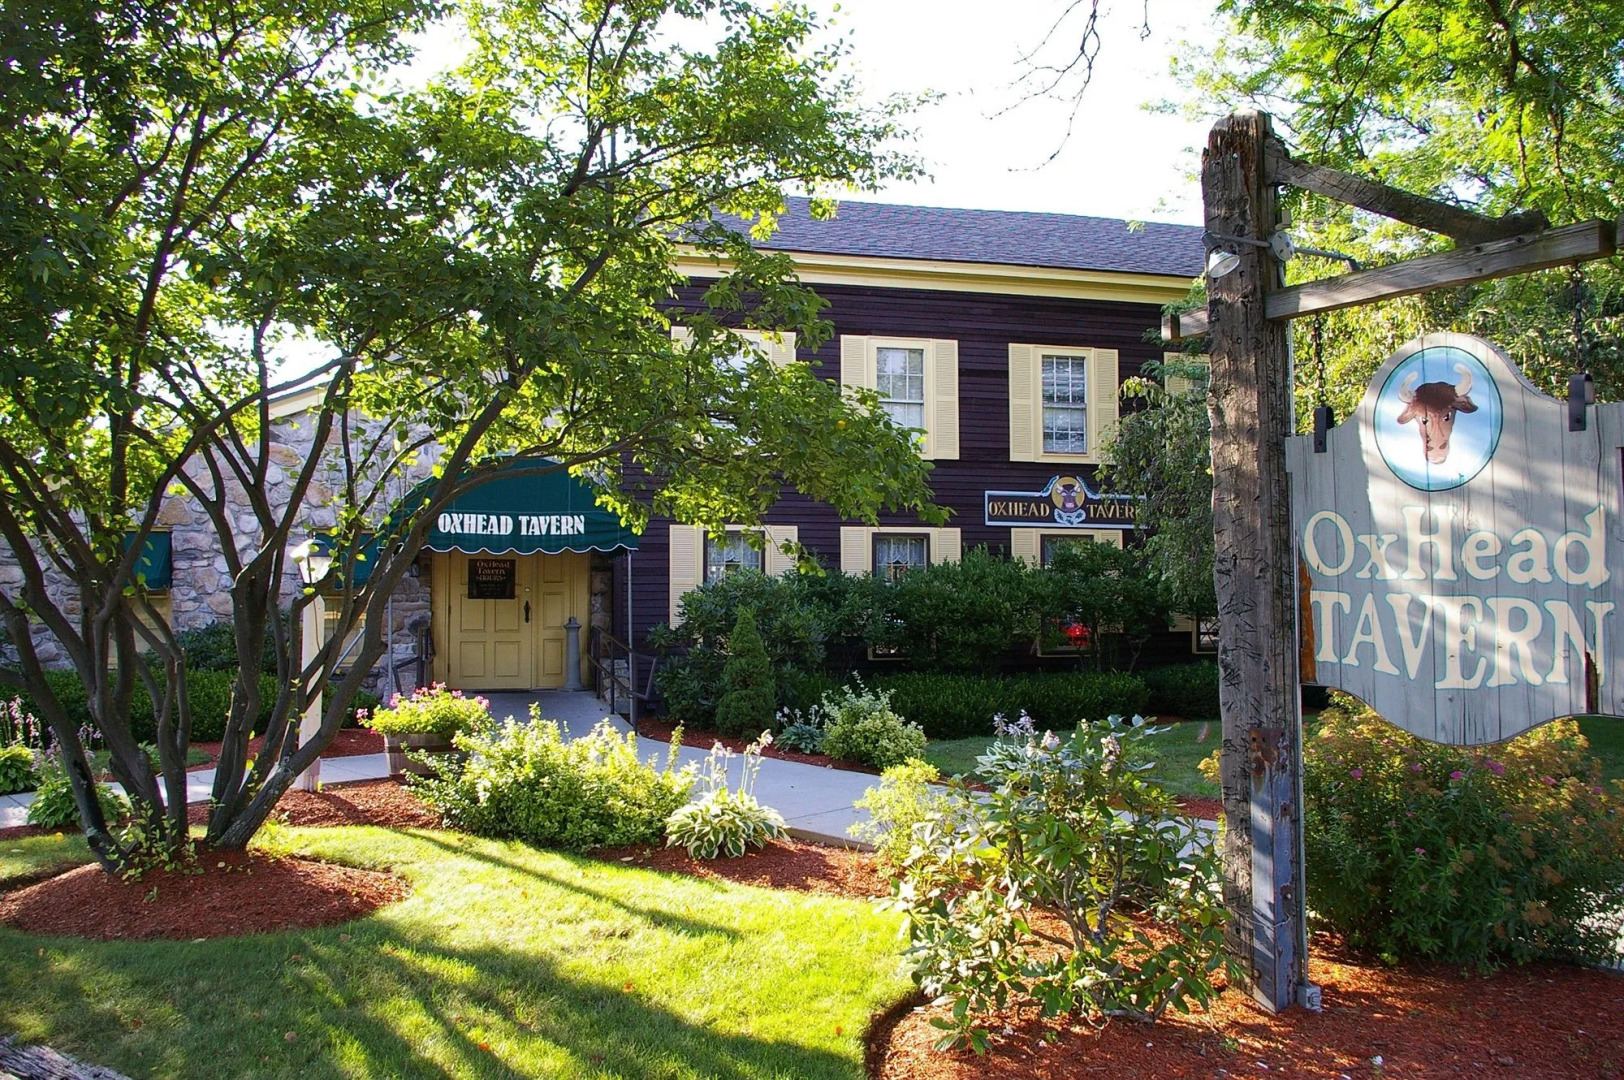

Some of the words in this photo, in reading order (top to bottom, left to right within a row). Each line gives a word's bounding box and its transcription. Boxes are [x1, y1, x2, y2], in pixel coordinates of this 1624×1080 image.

[437, 513, 514, 535] OXHEAD
[518, 515, 585, 536] TAVERN
[988, 501, 1050, 517] OXHEAD
[1086, 504, 1138, 519] TAVER
[1304, 504, 1611, 590] OxHead
[1309, 590, 1615, 689] TAVERN
